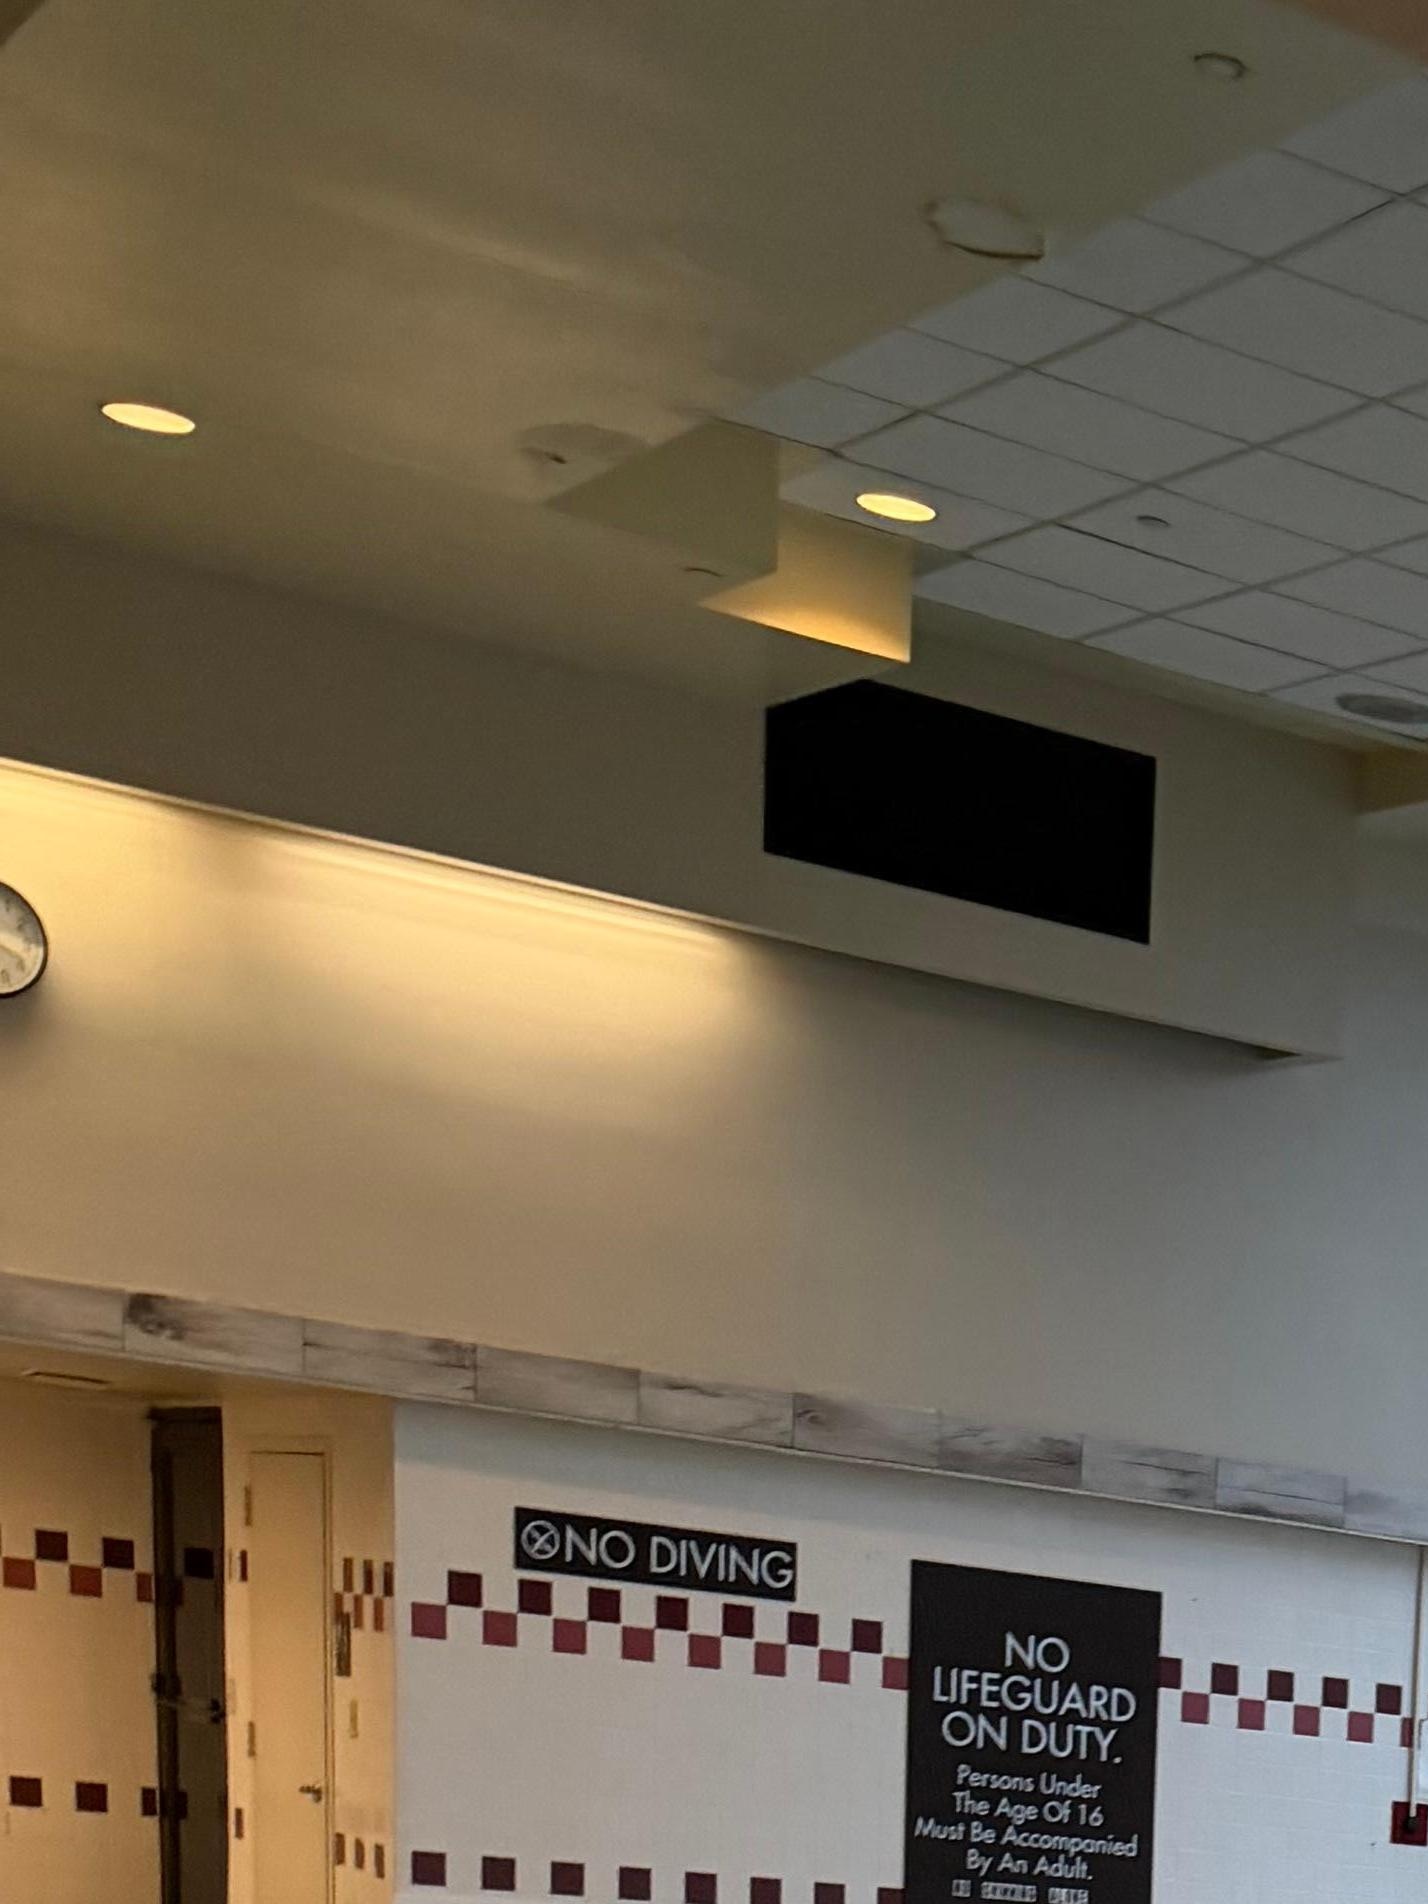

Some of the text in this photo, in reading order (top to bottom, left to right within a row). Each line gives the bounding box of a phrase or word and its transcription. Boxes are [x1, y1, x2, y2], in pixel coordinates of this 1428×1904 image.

[564, 1524, 793, 1589] NO DIVING
[1004, 1631, 1070, 1673] NO
[933, 1665, 1137, 1722] LIFEGUARD
[942, 1711, 1122, 1764] ON DUTY.
[956, 1764, 1102, 1799] Persons Under
[952, 1790, 1104, 1826] The Age Of 16
[914, 1816, 1139, 1858] Must Be Accompanied
[966, 1848, 1094, 1881] By An Adult.
